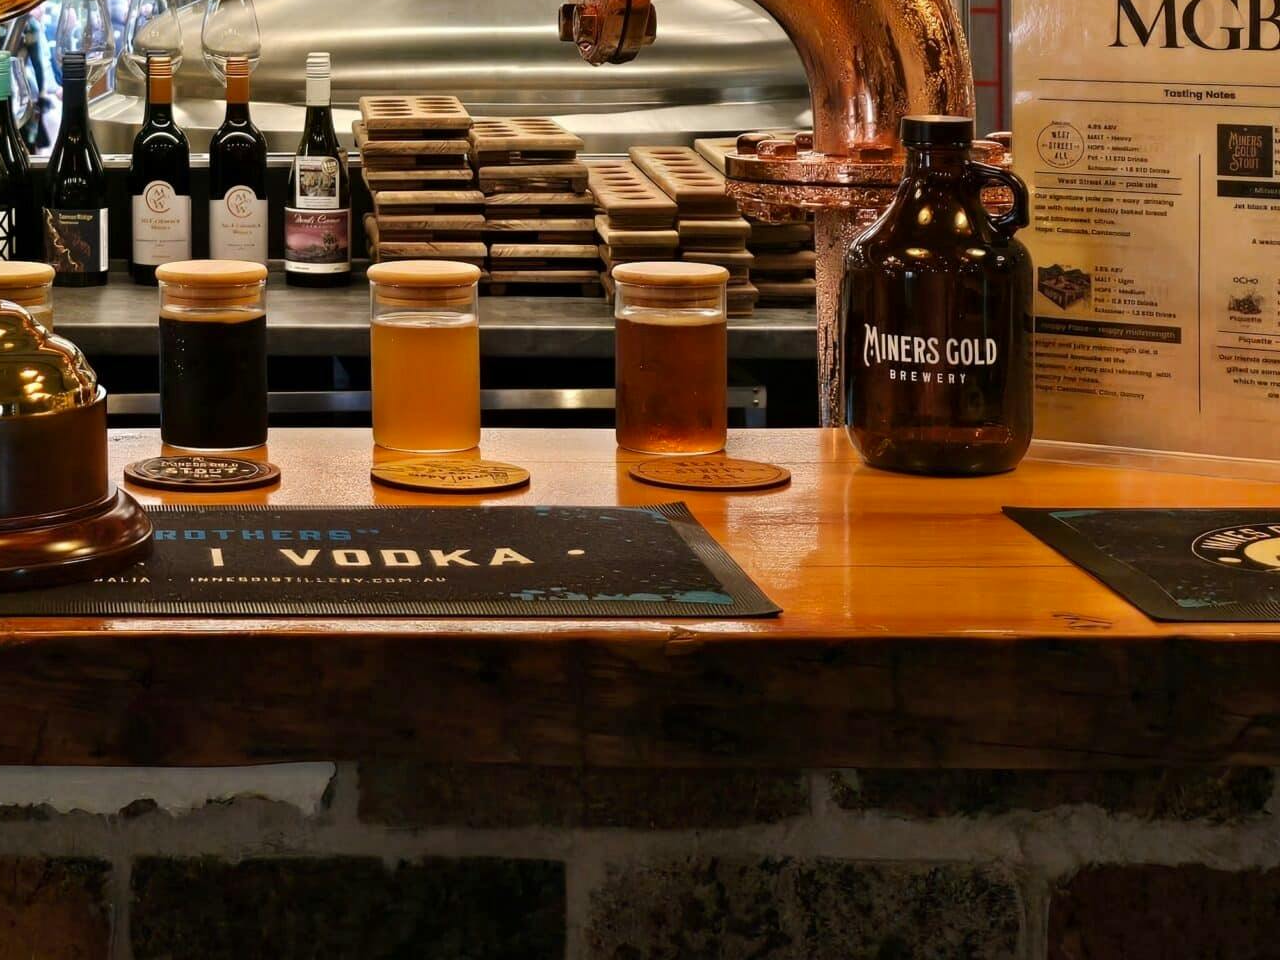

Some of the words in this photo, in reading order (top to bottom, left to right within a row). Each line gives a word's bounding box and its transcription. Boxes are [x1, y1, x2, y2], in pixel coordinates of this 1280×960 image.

[1163, 88, 1203, 101] Tasting
[1205, 91, 1236, 100] Notes
[1051, 131, 1070, 140] WEST
[1048, 141, 1073, 150] STREET
[1057, 177, 1077, 185] West
[1079, 178, 1102, 186] Street
[1233, 277, 1259, 285] OCHO
[946, 338, 998, 366] GOLD
[889, 369, 967, 385] BREWERY
[1233, 378, 1256, 386] which
[280, 548, 535, 567] VODKA
